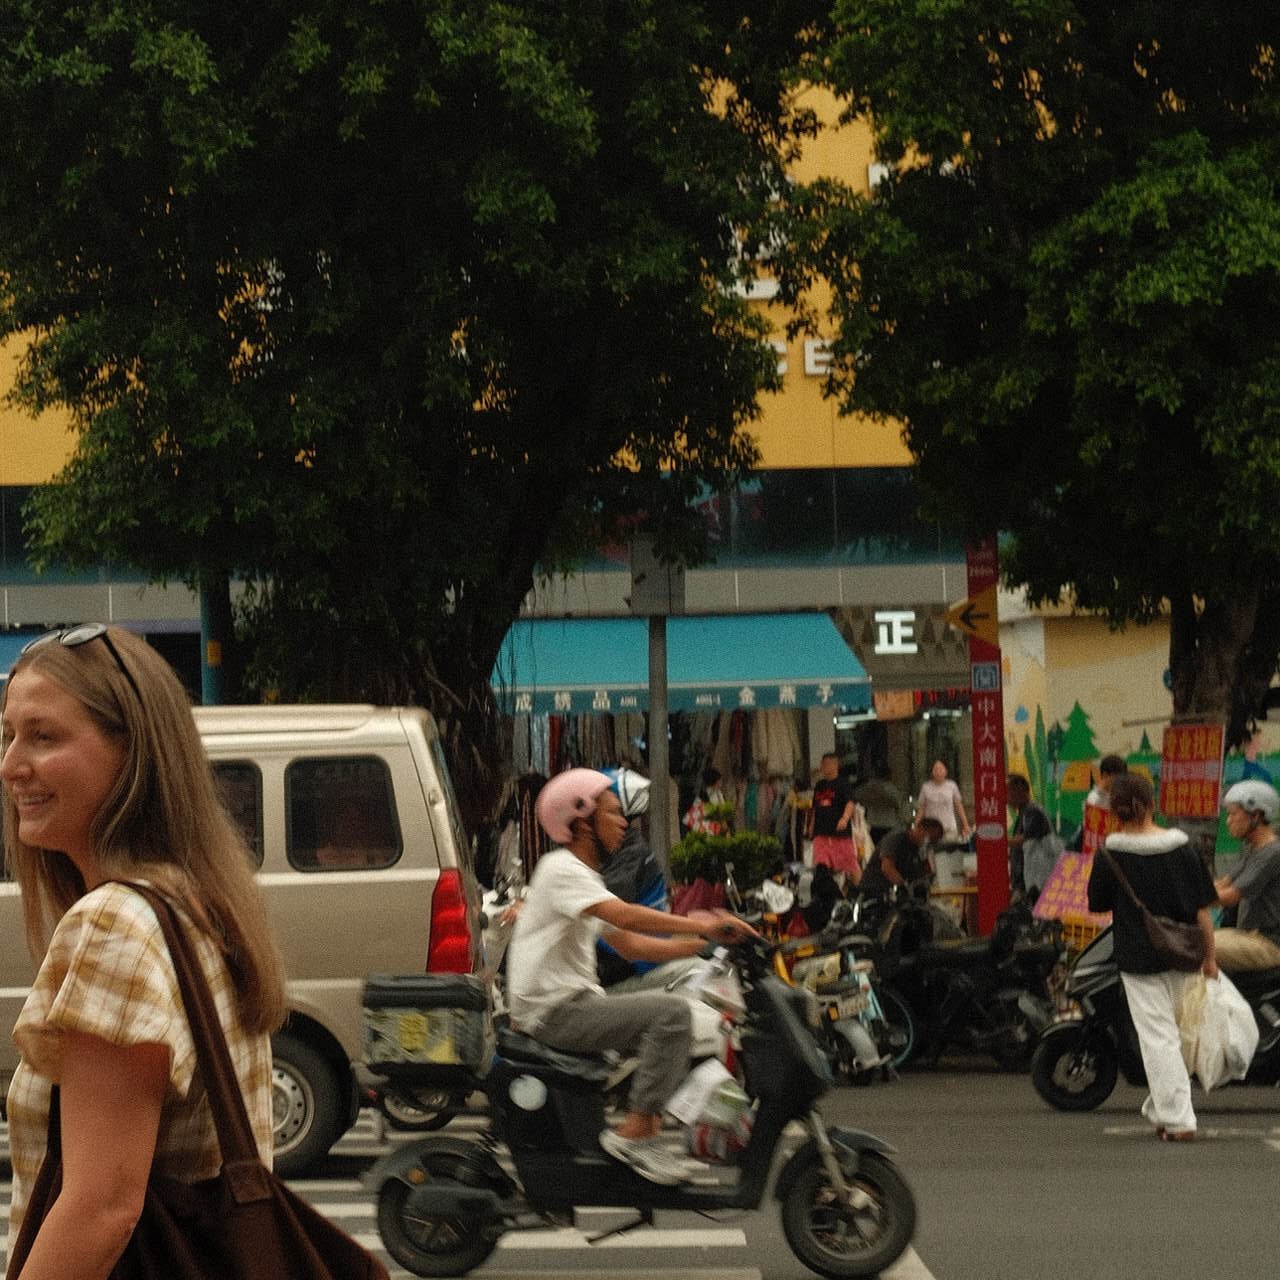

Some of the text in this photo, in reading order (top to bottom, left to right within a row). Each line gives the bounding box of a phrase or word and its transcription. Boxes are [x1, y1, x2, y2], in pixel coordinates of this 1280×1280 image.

[873, 610, 918, 654] 正
[977, 696, 999, 817] 中大南门站
